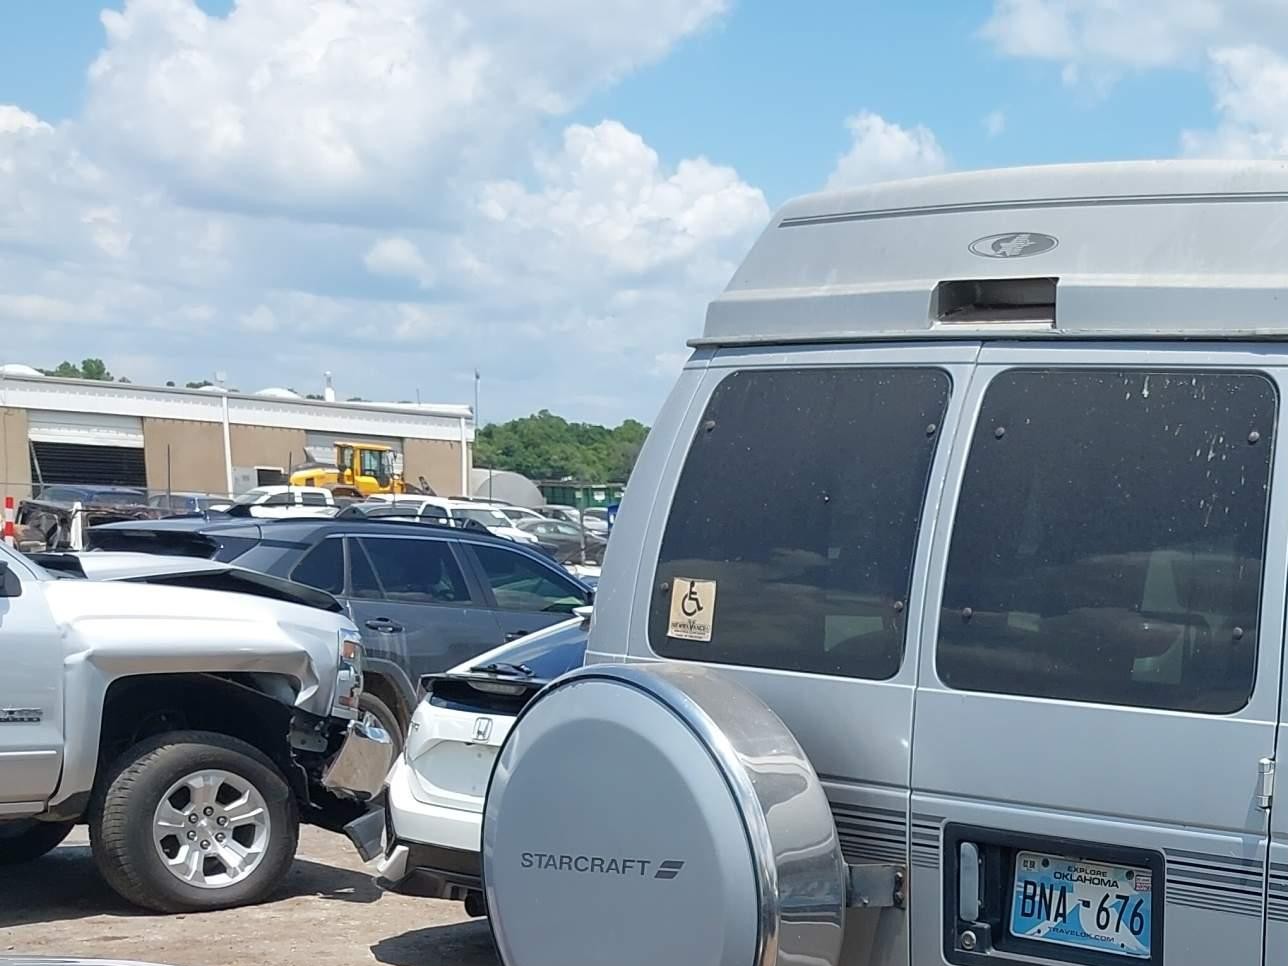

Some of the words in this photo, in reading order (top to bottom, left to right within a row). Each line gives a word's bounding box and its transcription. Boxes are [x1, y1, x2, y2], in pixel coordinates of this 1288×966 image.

[520, 852, 652, 876] STARCRAFT
[1066, 865, 1108, 878] EXPLORE
[1053, 871, 1120, 889] OKLAHOMA
[1047, 926, 1115, 943] TRAVELOK.COM
